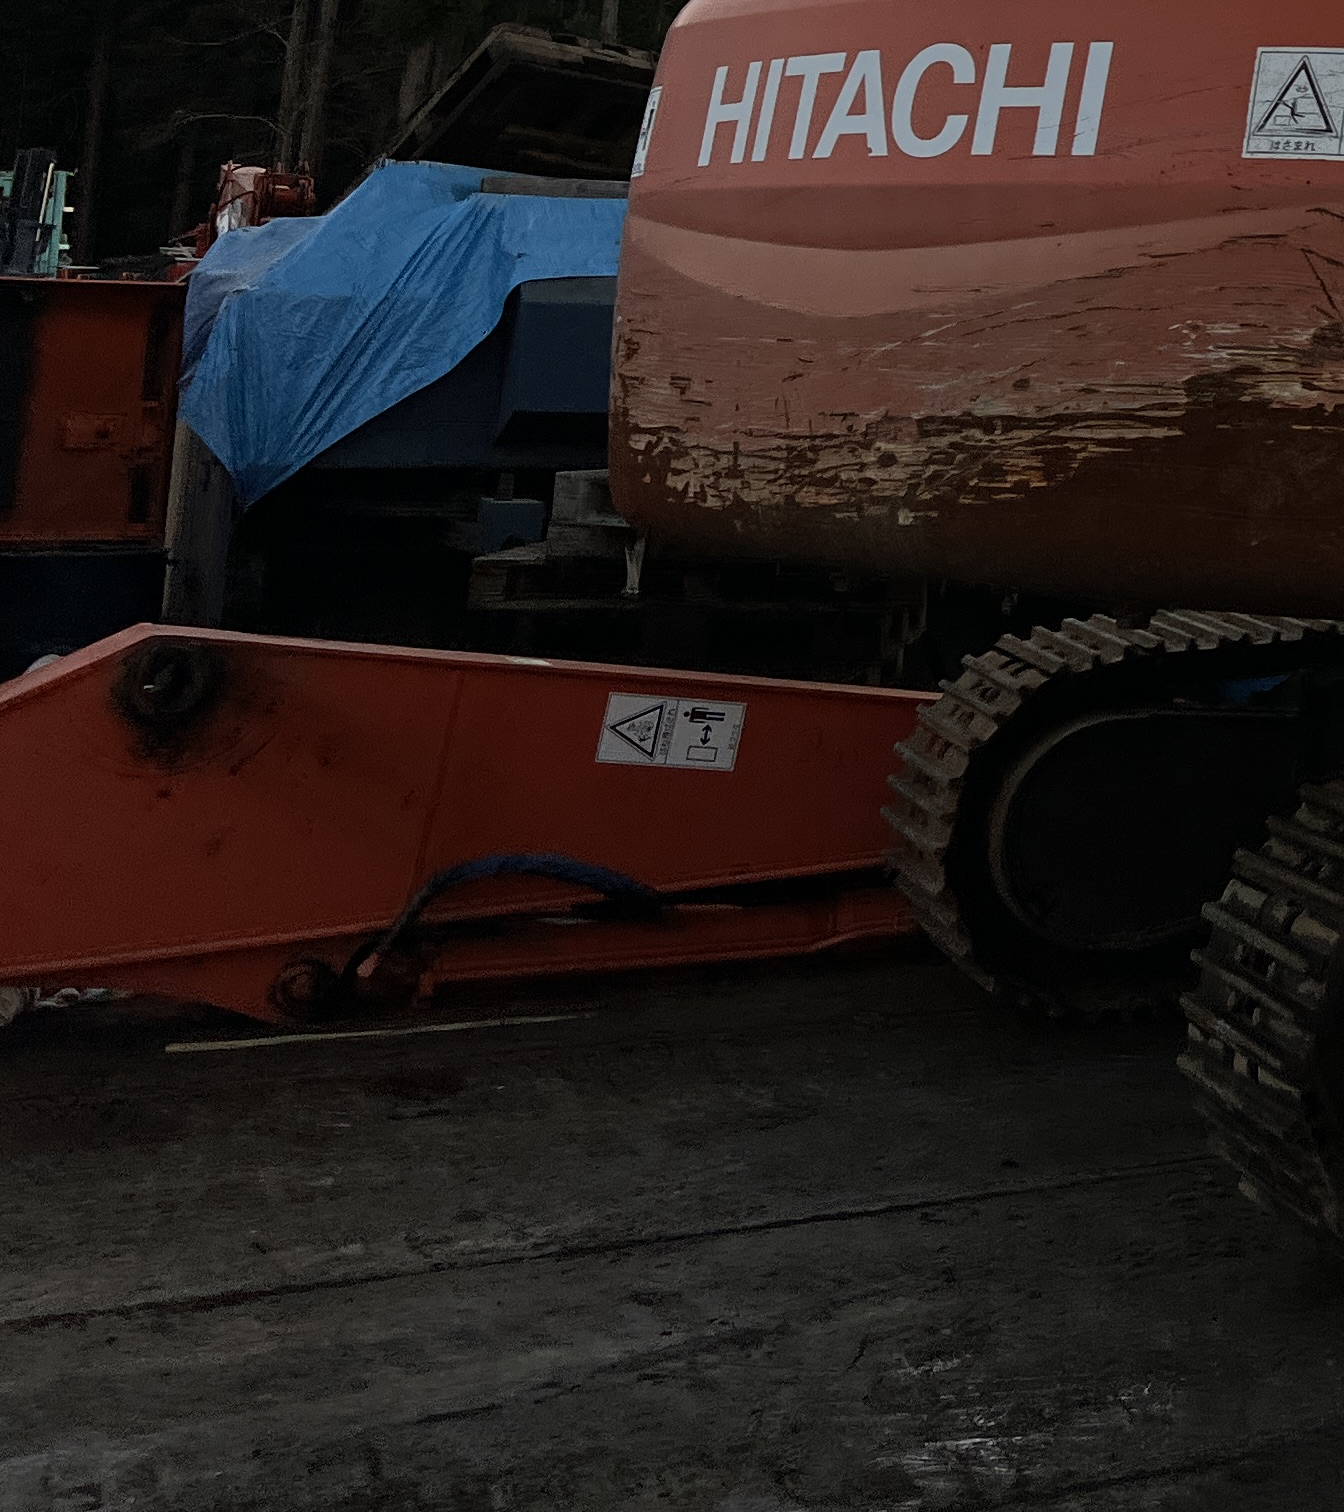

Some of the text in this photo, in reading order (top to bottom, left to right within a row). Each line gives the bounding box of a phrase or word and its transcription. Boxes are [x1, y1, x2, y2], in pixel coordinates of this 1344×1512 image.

[698, 42, 1113, 166] HITACHI
[1270, 139, 1316, 151] はさまれ
